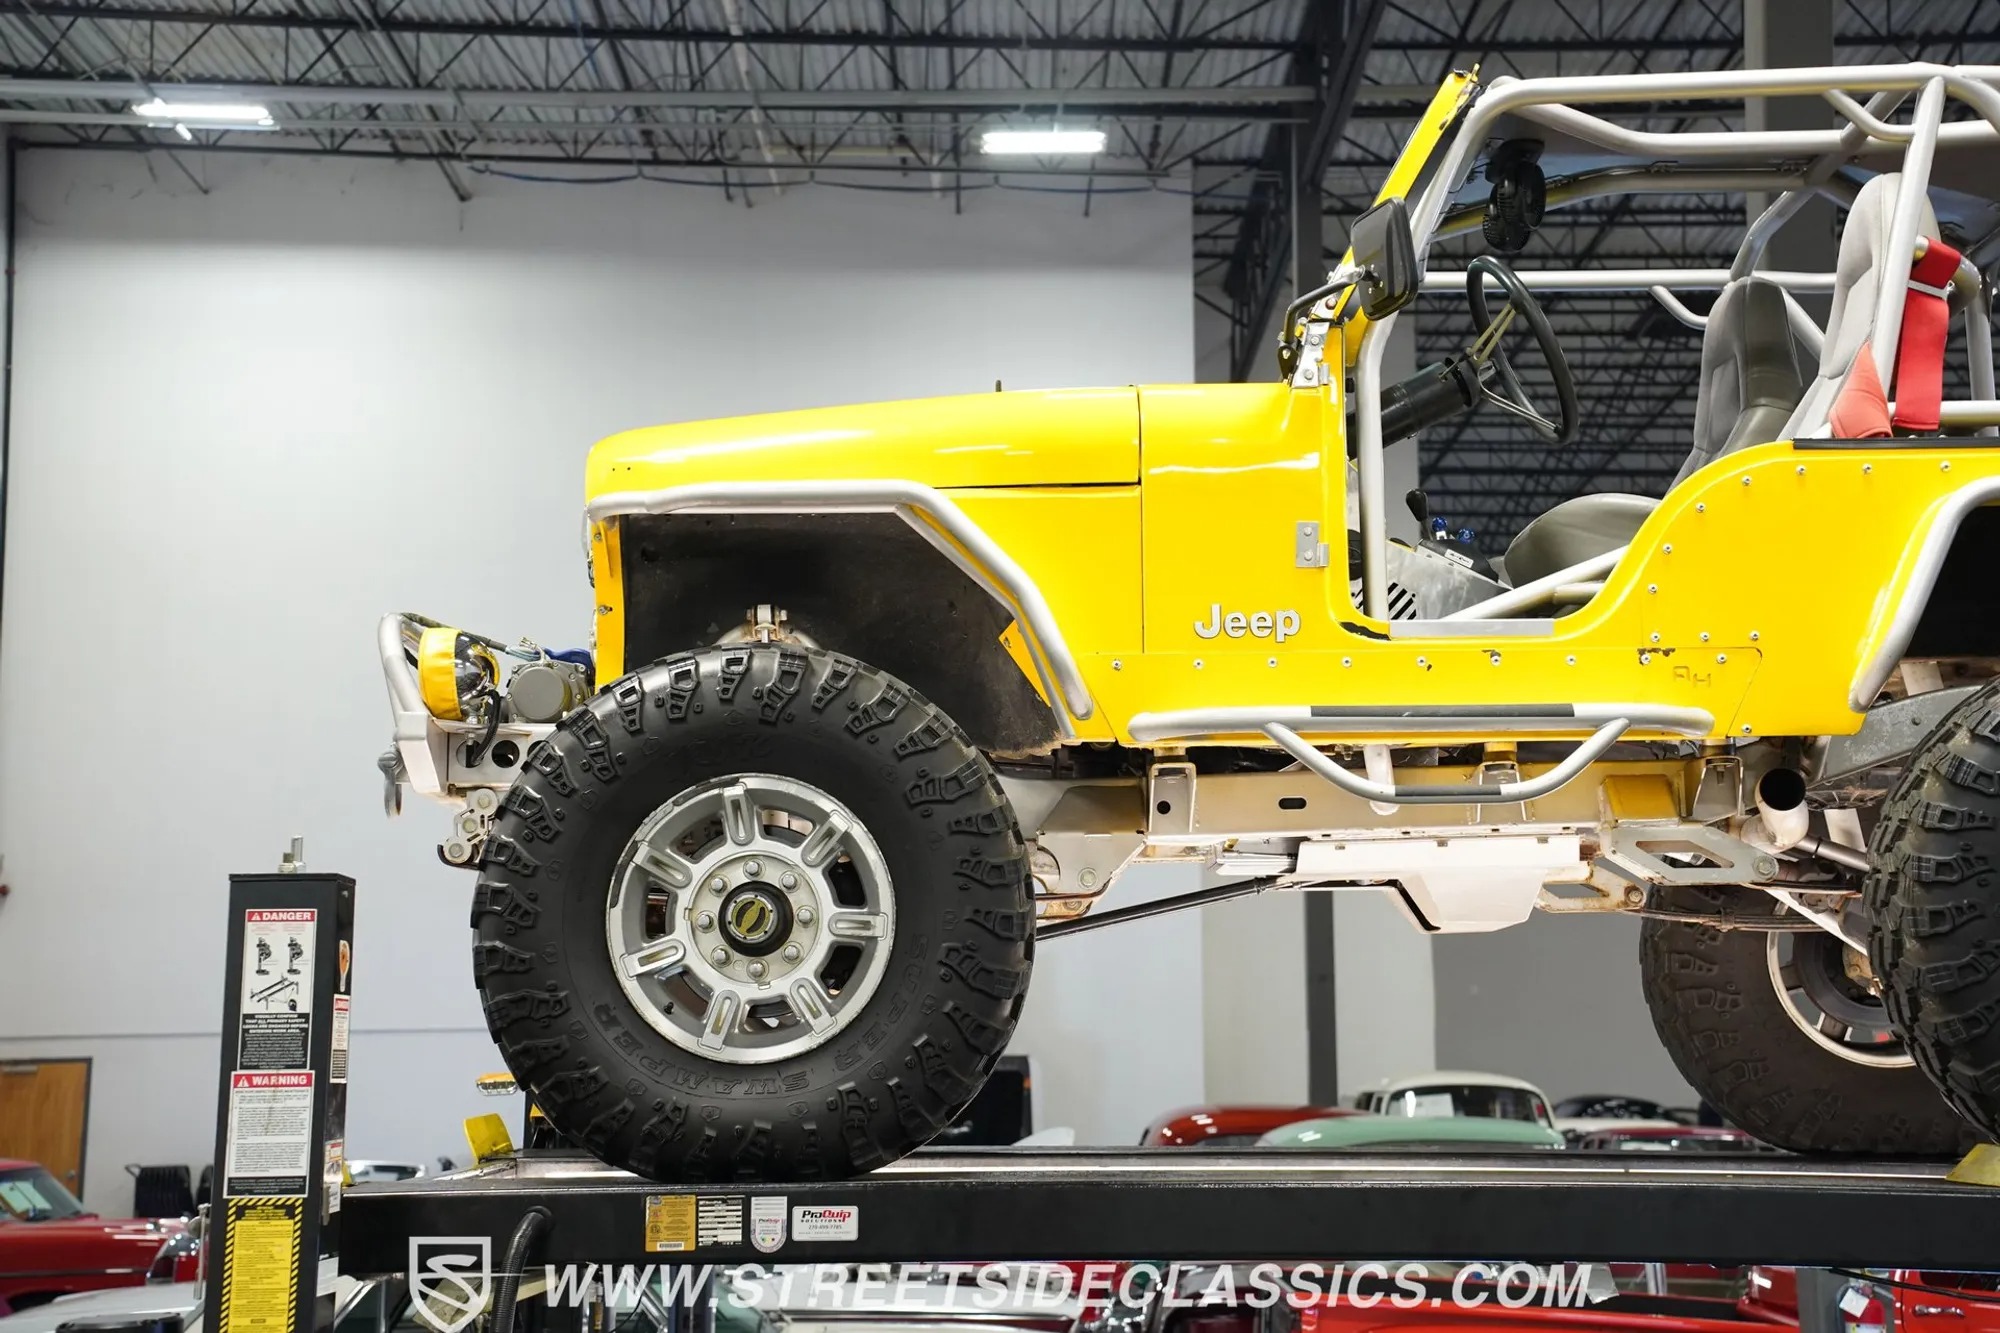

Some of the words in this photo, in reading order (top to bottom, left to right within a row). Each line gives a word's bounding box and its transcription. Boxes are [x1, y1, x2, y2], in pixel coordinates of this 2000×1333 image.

[1193, 603, 1301, 644] Jeep
[262, 912, 311, 921] DANGER
[592, 1002, 810, 1096] SWAMPER
[252, 1075, 307, 1086] WARNING
[802, 1209, 851, 1223] ProQuip
